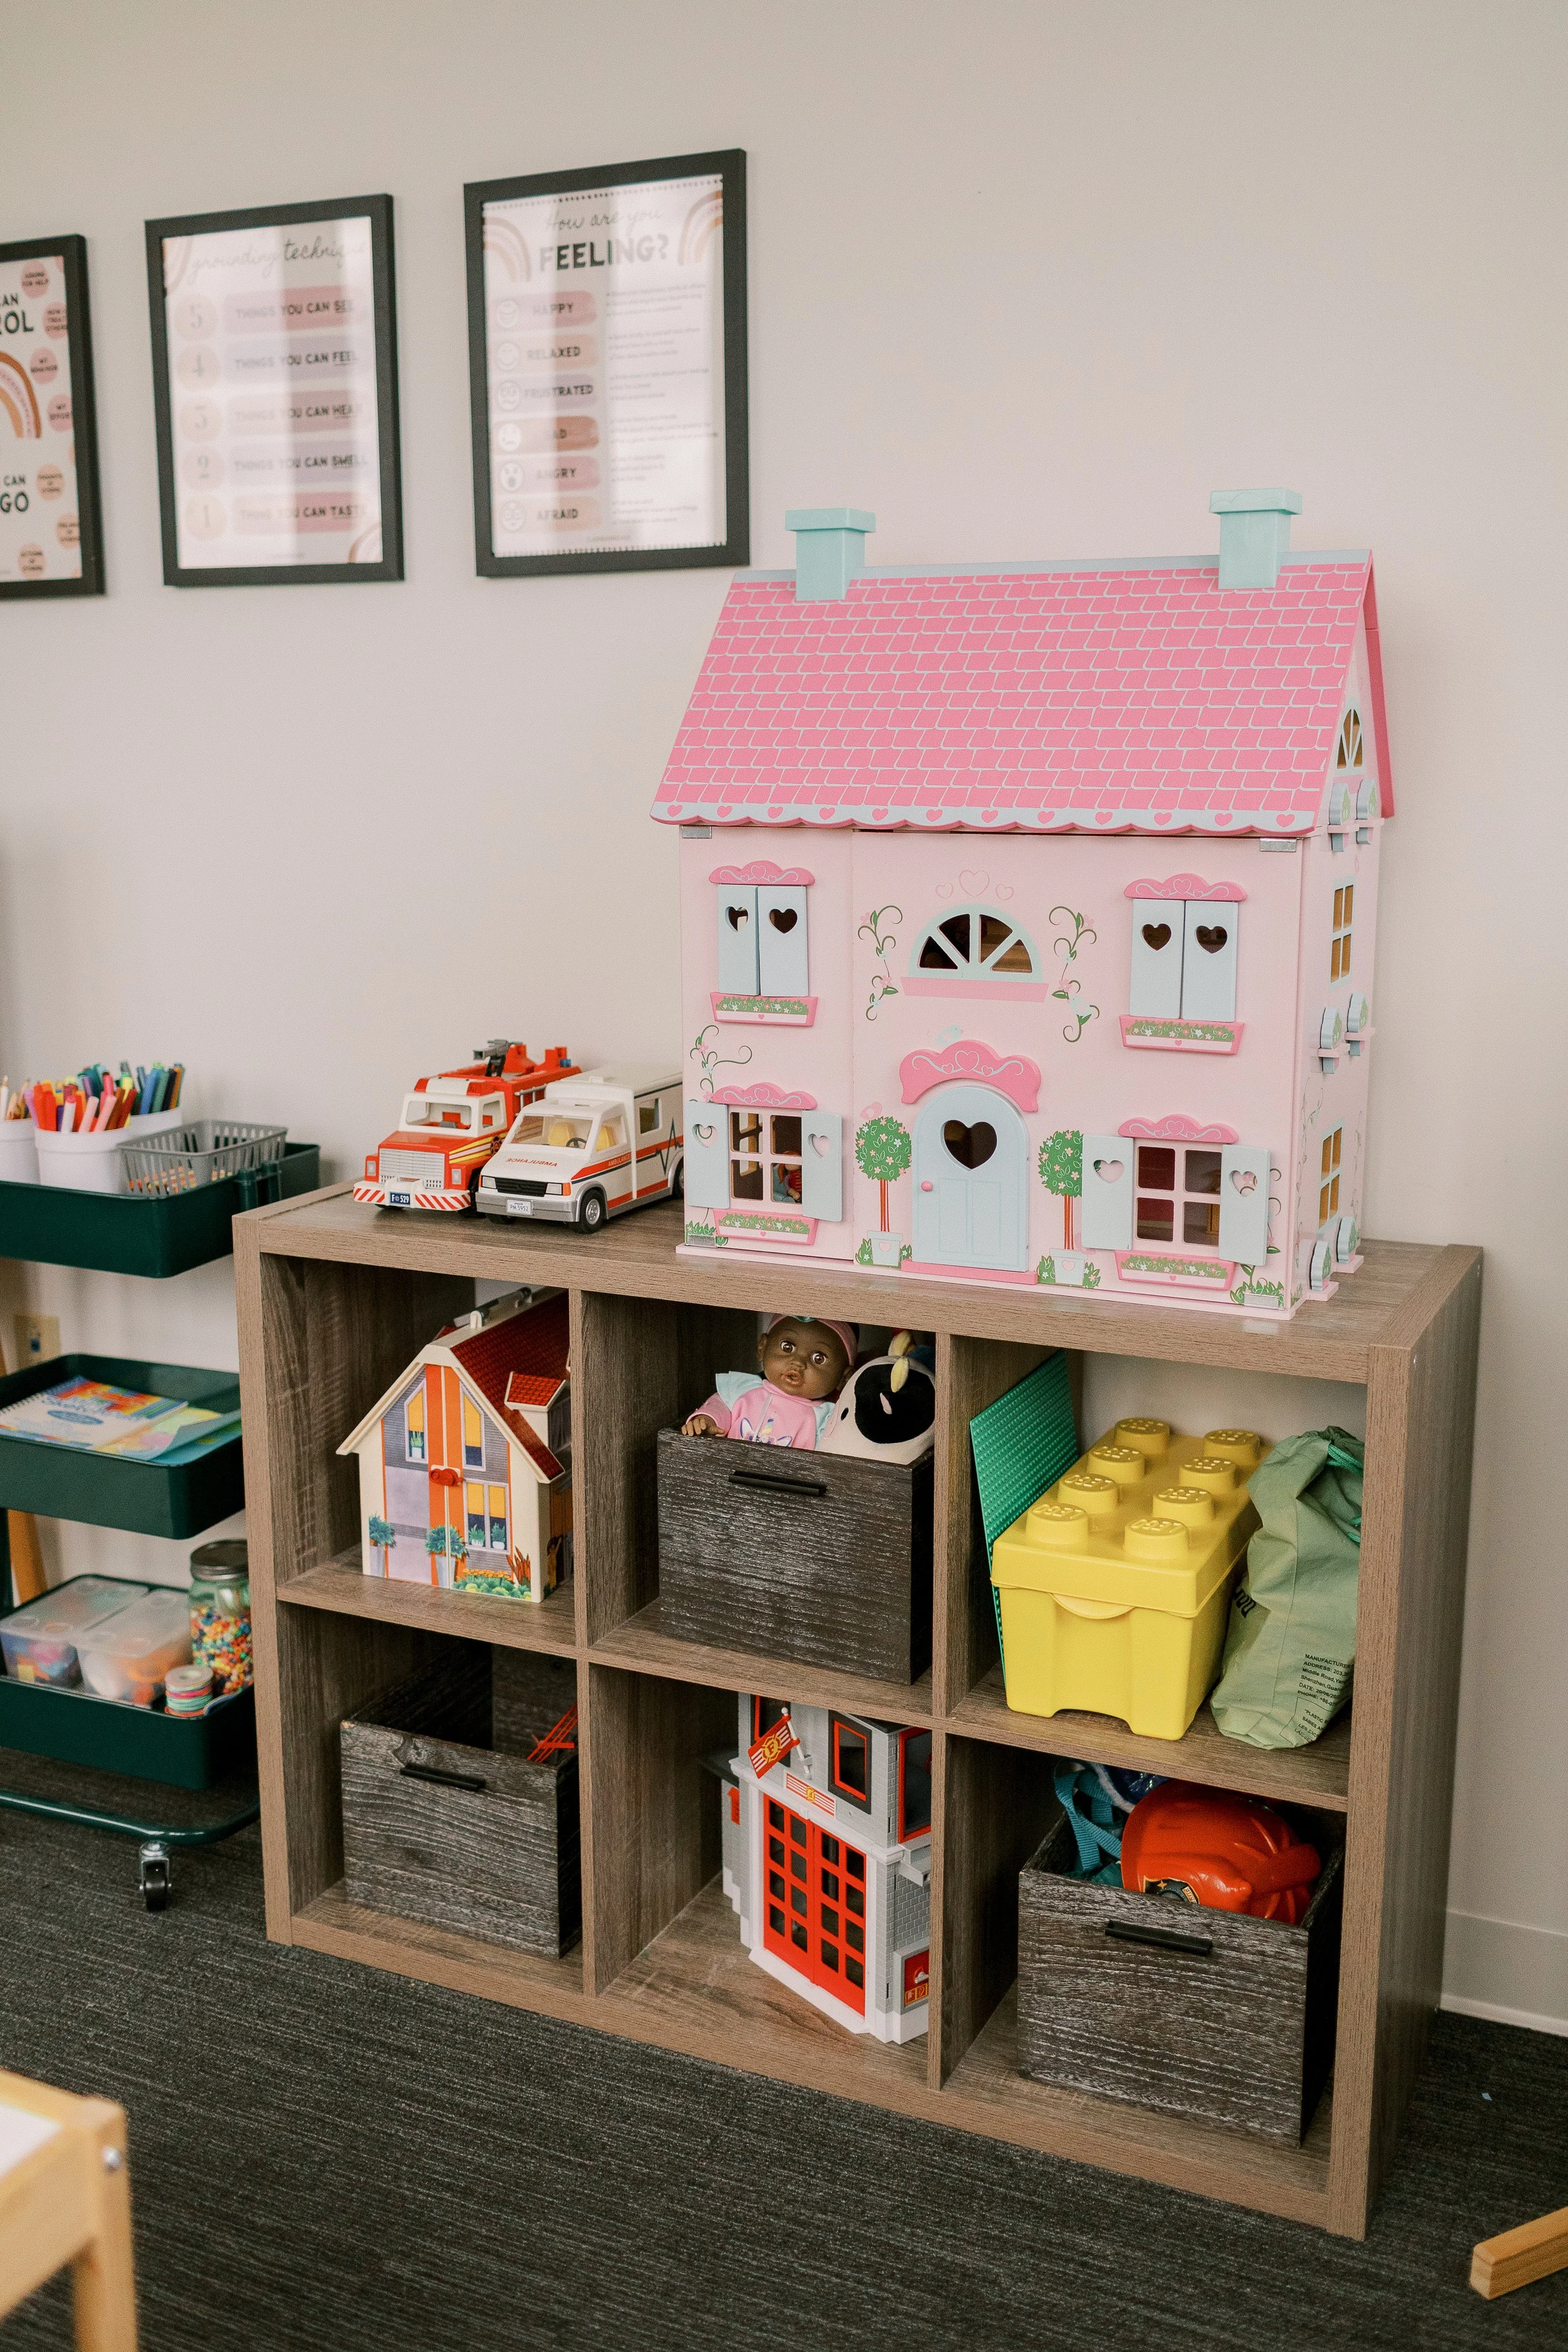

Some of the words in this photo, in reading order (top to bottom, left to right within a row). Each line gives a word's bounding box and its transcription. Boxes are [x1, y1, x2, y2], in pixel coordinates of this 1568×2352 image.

[590, 211, 623, 226] are
[627, 208, 662, 237] you
[539, 233, 669, 272] FEELING?
[2, 292, 18, 306] AN
[306, 300, 330, 314] CAN
[305, 351, 329, 364] CAN
[526, 346, 582, 361] RELAXED
[523, 383, 595, 399] FRUSTRATED
[305, 406, 329, 418] CAN
[304, 456, 328, 469] CAN
[302, 506, 327, 519] CAN
[536, 507, 580, 521] AFRAID
[400, 1195, 410, 1204] 529
[1302, 1668, 1320, 1677] Middle
[1303, 1661, 1332, 1673] ADDRESS:
[1299, 1682, 1315, 1692] DATE:
[1315, 1688, 1338, 1699] 20/06/20
[1297, 1690, 1319, 1700] PHONE:
[1320, 1697, 1333, 1706] +86-0
